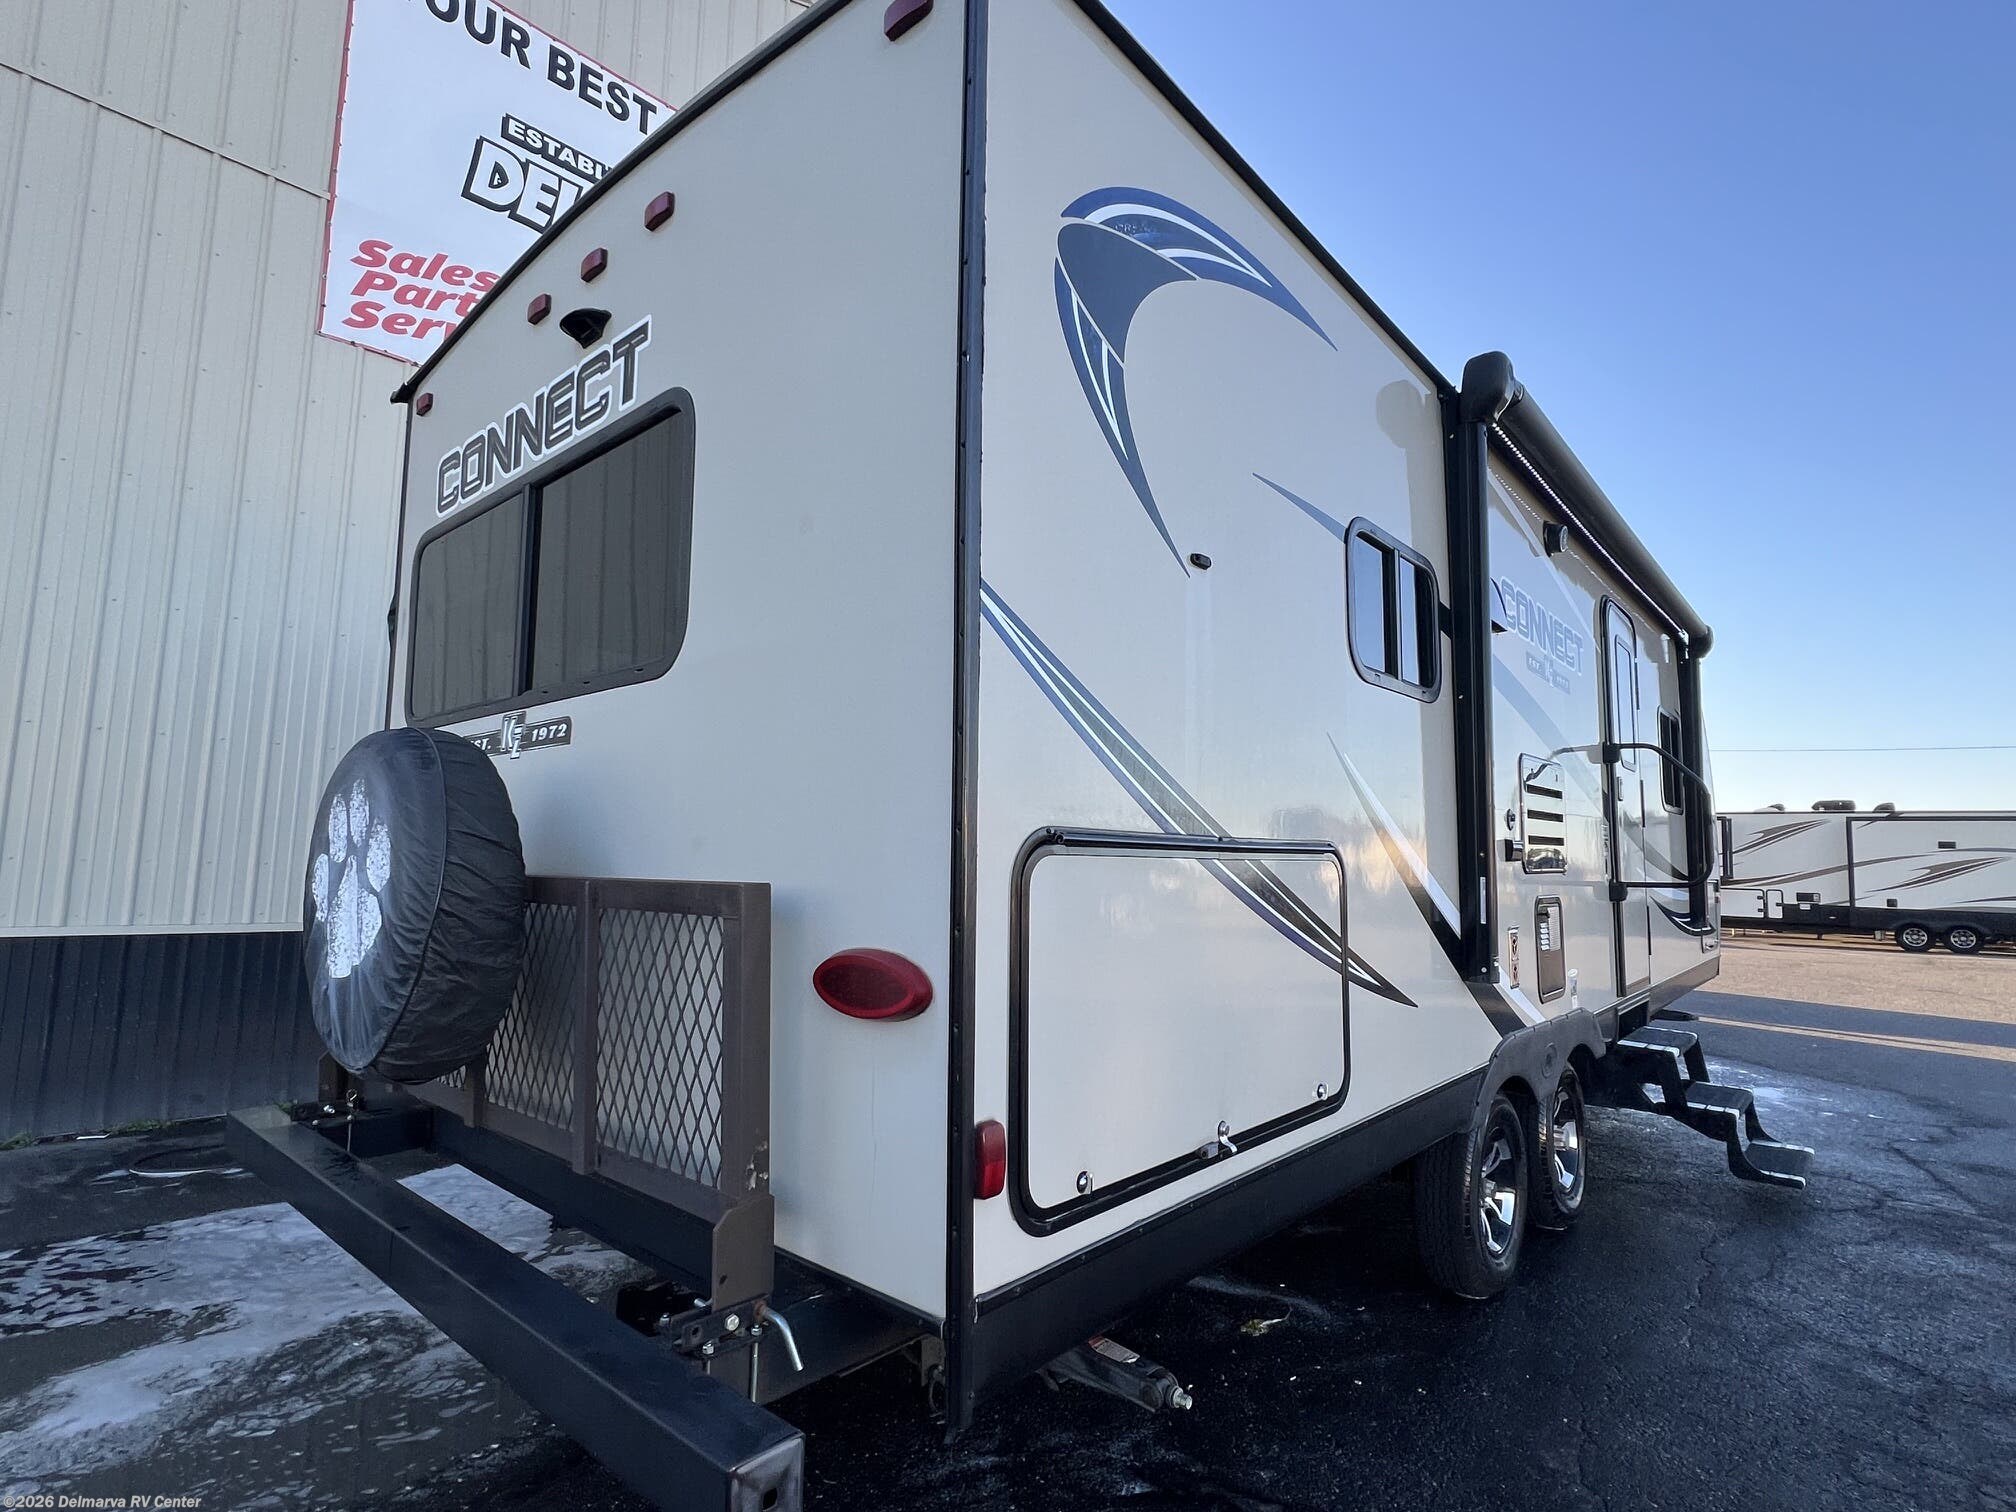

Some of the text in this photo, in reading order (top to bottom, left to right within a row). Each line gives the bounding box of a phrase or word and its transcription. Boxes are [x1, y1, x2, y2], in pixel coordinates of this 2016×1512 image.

[408, 0, 657, 135] OUR BEST
[350, 239, 501, 293] Sales
[436, 315, 652, 518] CONNECT
[1501, 577, 1583, 676] CONNECT
[531, 723, 568, 742] 1972
